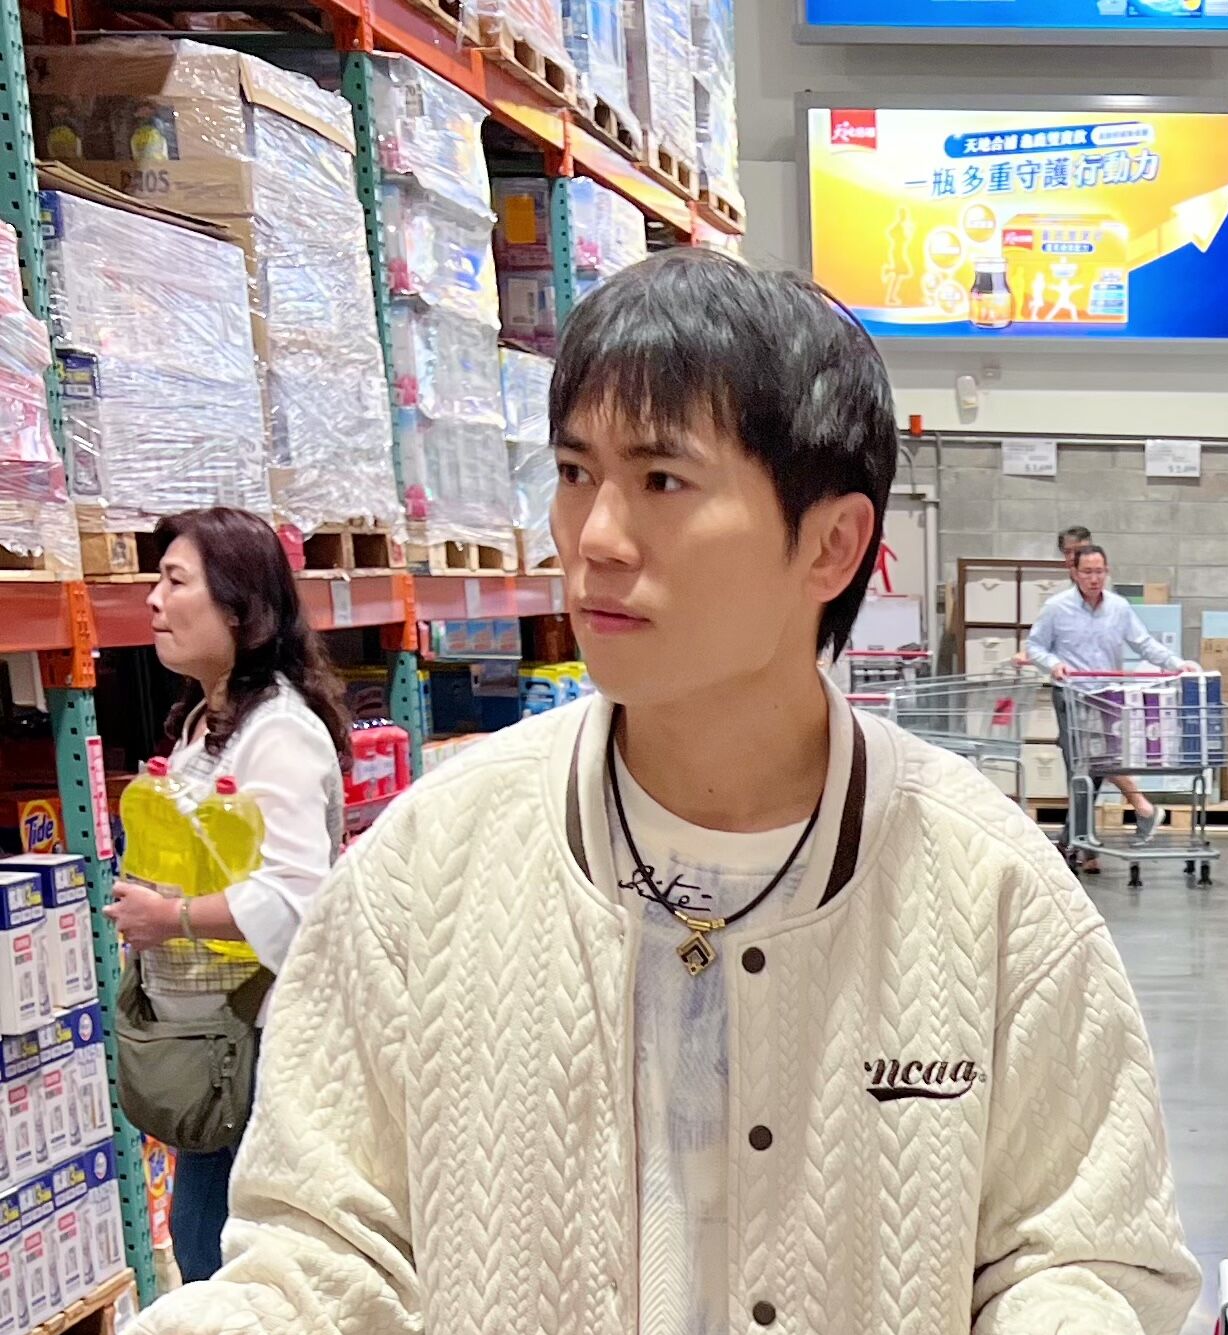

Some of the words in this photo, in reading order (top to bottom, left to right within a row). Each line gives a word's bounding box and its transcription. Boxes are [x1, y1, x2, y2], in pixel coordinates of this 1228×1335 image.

[905, 149, 1159, 198] 一瓶多重守護行動力
[25, 813, 54, 845] Tide
[864, 1056, 978, 1087] ncaa
